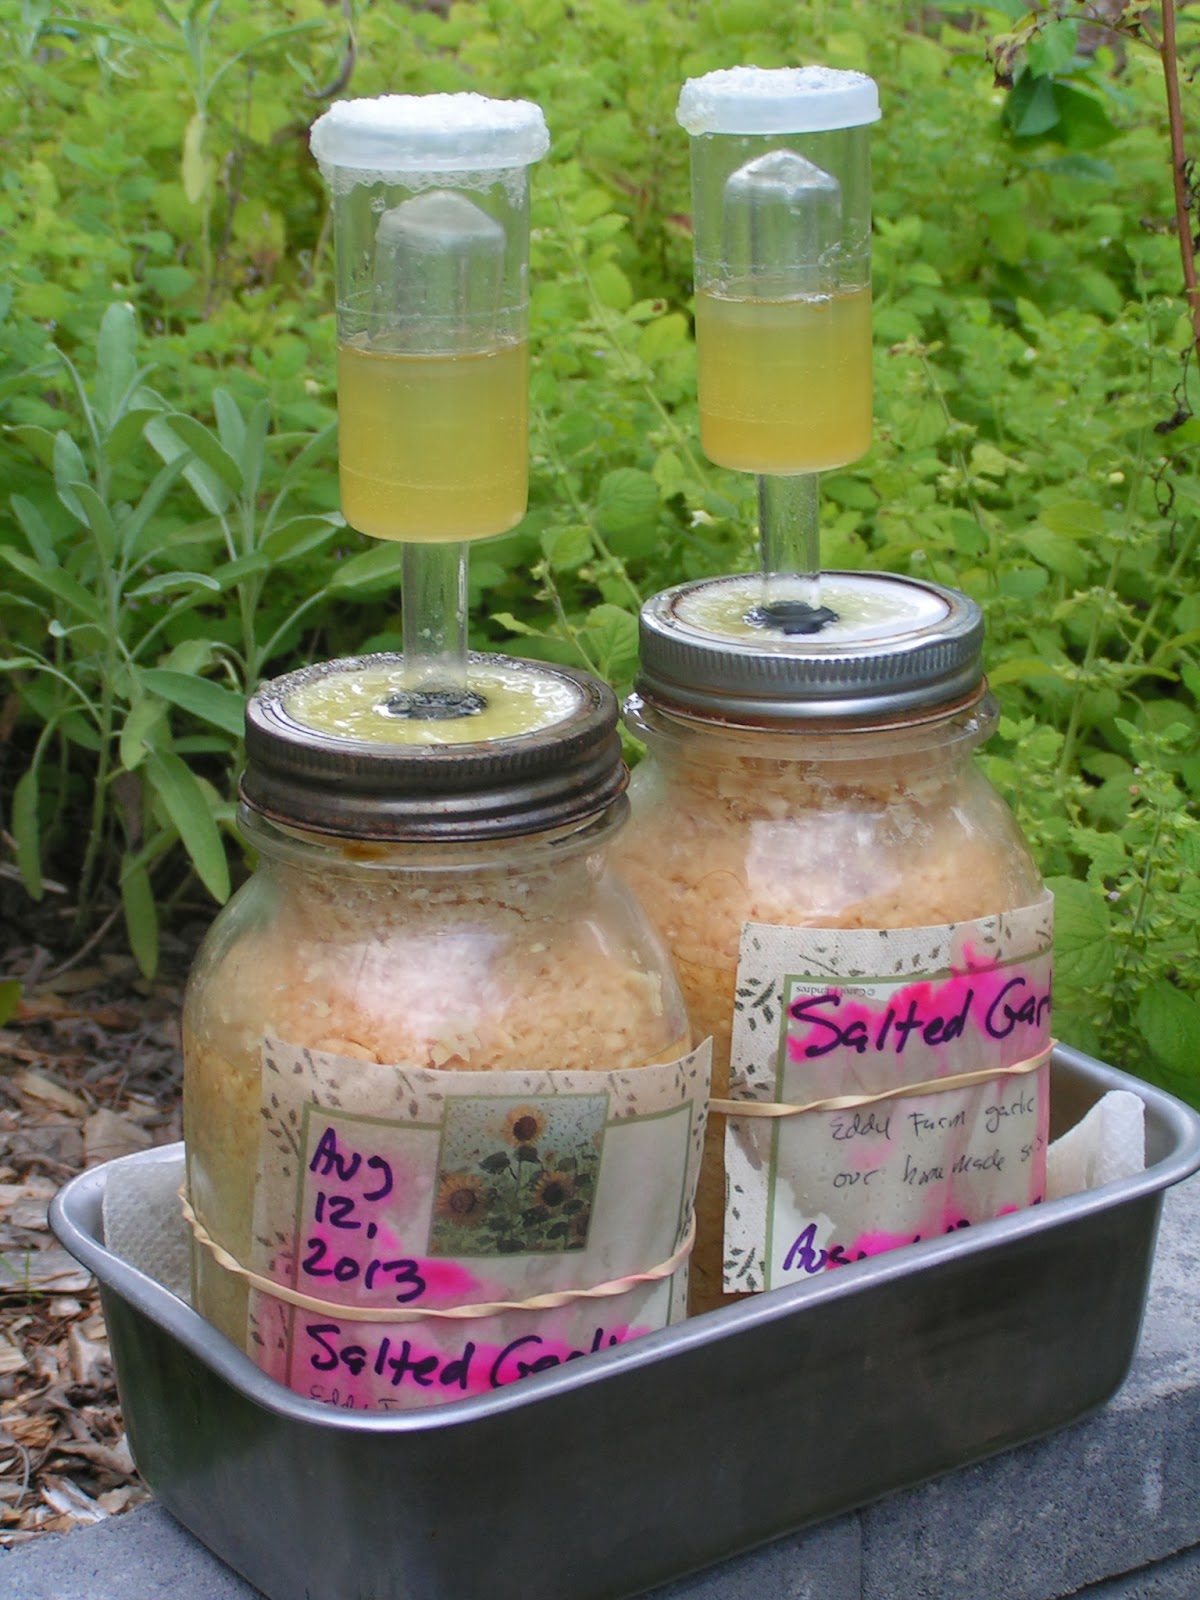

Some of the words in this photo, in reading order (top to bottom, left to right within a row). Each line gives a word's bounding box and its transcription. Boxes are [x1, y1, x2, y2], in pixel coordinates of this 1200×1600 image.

[790, 988, 974, 1057] Salted
[309, 1126, 394, 1201] Aug
[314, 1191, 378, 1240] 12,
[301, 1238, 427, 1303] 2013
[306, 1325, 477, 1391] Salted
